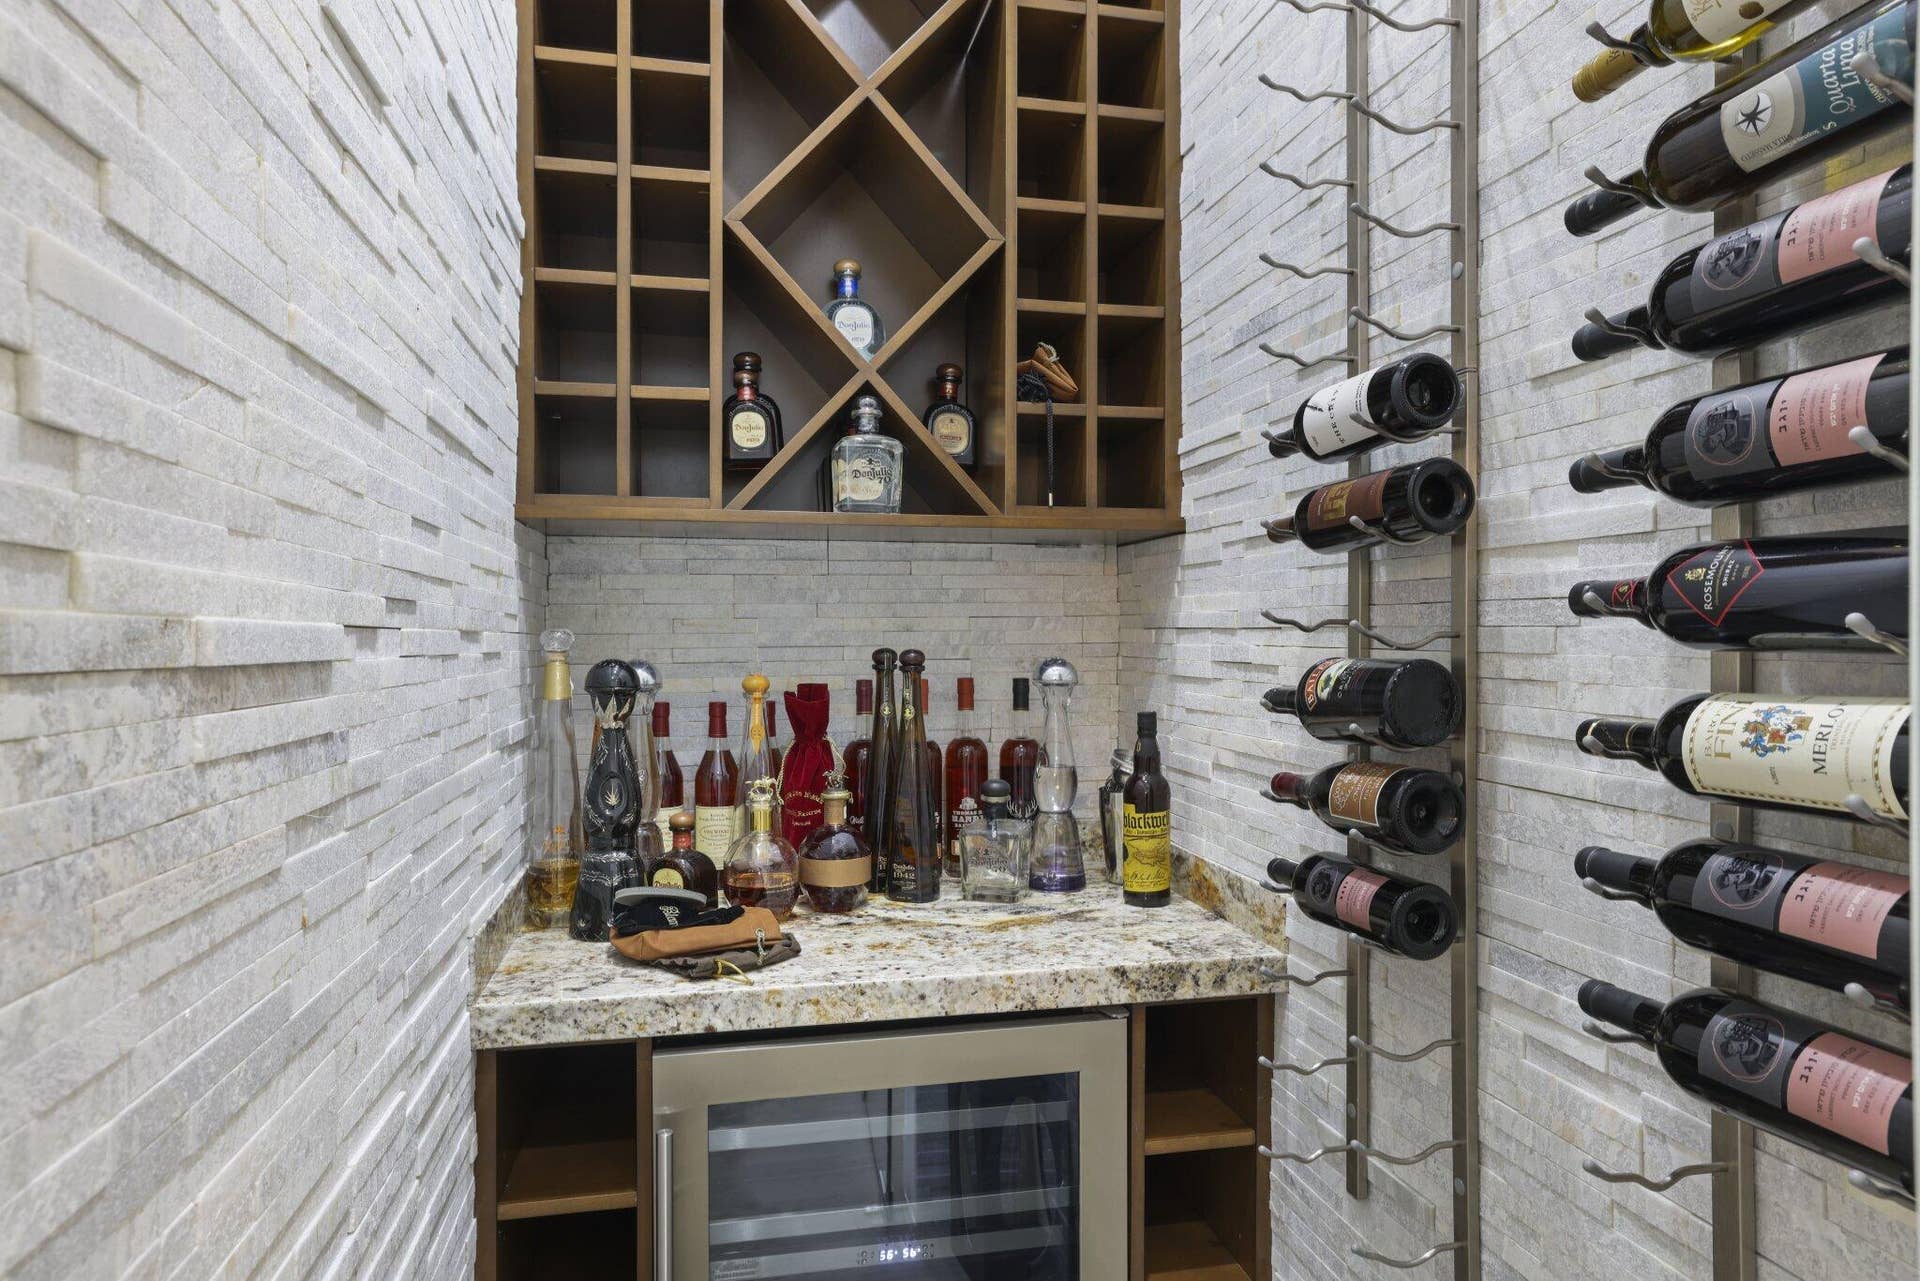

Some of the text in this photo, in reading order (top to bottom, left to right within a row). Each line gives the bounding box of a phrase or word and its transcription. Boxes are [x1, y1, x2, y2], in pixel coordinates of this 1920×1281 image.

[1819, 48, 1856, 114] Quarta
[852, 466, 893, 481] DonJulio
[878, 476, 892, 484] 70
[1722, 558, 1736, 588] SHIRAZ
[1123, 811, 1170, 829] blackwel
